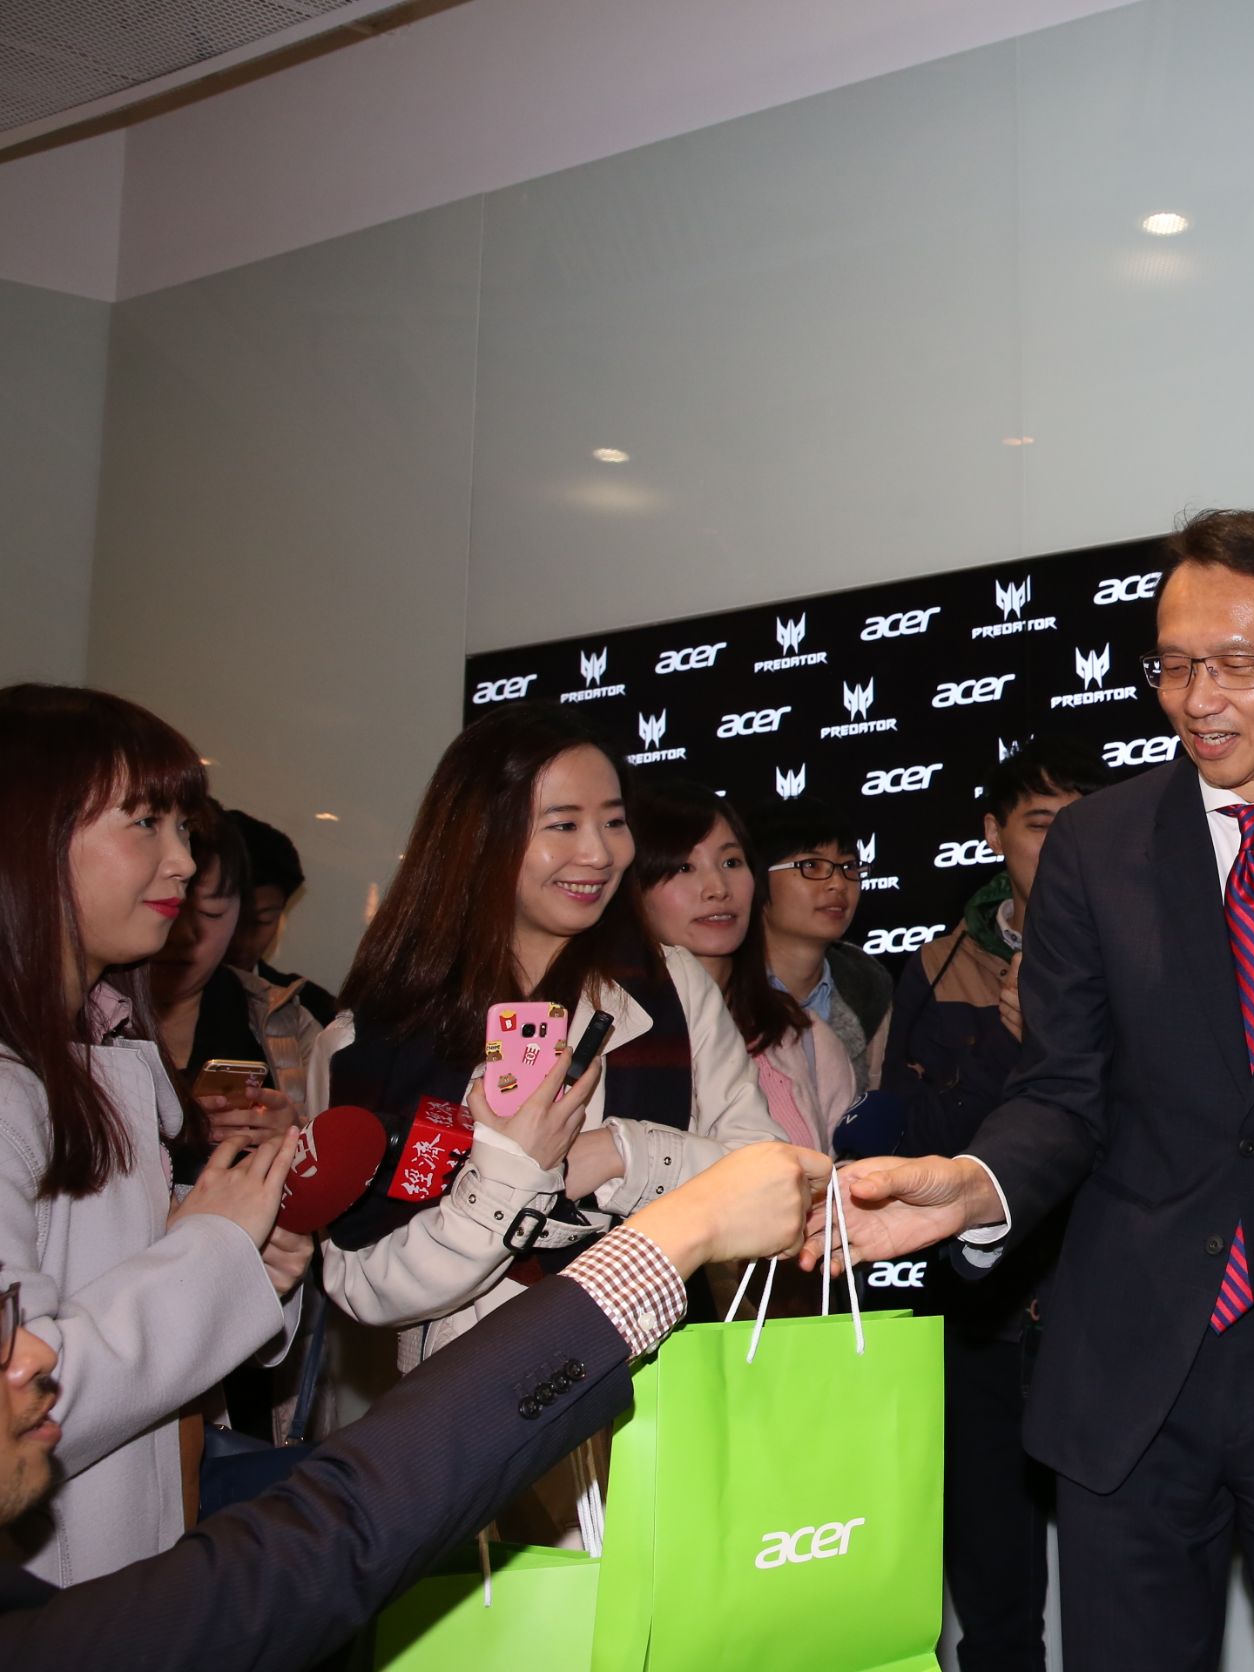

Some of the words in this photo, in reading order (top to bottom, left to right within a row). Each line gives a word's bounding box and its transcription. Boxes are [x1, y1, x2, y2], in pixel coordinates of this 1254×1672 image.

[1093, 571, 1163, 605] ace
[860, 606, 941, 641] acer
[971, 616, 1057, 639] PREDATOR
[654, 641, 727, 674] acer
[754, 652, 828, 673] PREDATOR
[472, 673, 538, 704] acer
[560, 683, 626, 704] PREDATOR
[931, 673, 1016, 708] acer
[1050, 686, 1138, 708] PREDATOR
[716, 706, 792, 739] acer
[820, 718, 898, 739] PREDATOR
[627, 747, 687, 766] REDATOR
[1101, 734, 1181, 768] acer
[861, 762, 944, 796] acer
[933, 839, 1005, 868] ace
[861, 876, 900, 890] ATOR
[862, 924, 946, 955] acer
[867, 1261, 928, 1288] ace
[755, 1517, 865, 1570] acer
